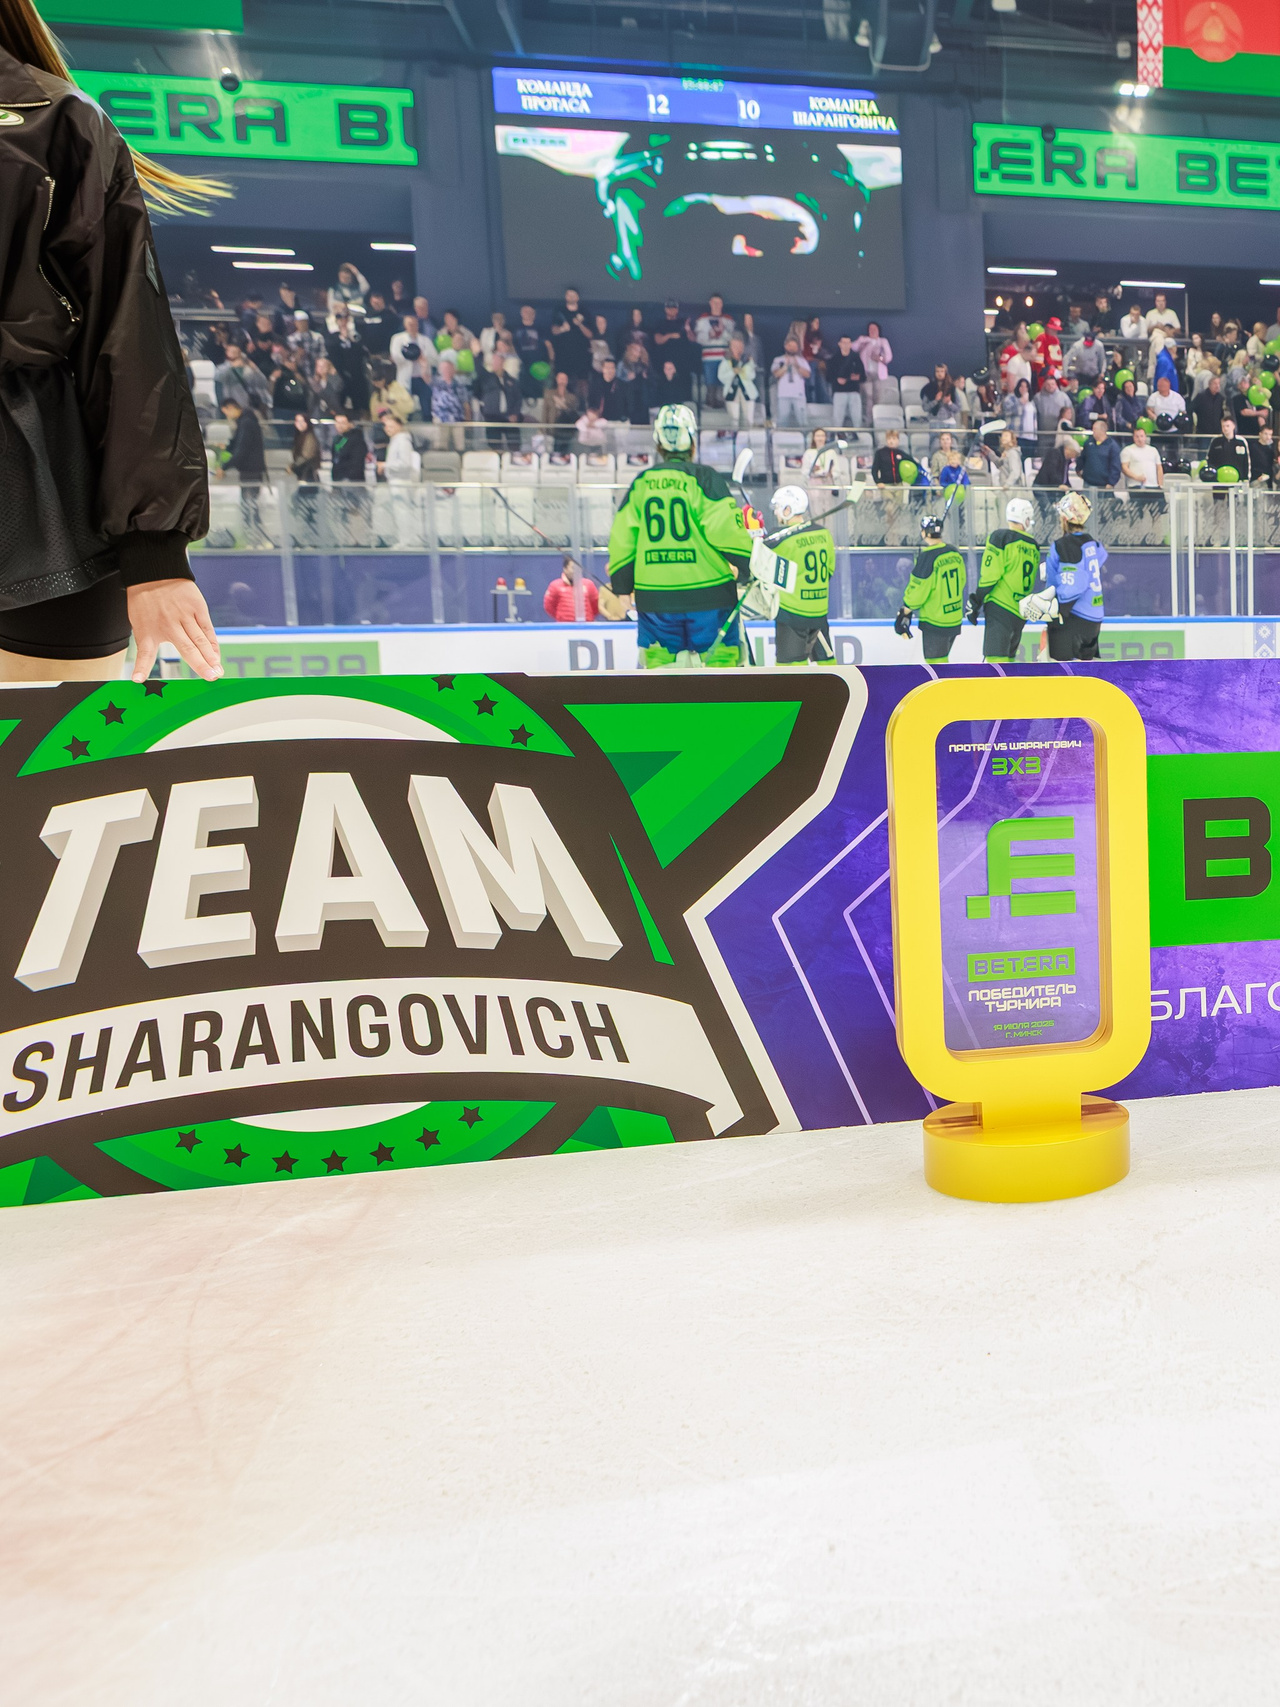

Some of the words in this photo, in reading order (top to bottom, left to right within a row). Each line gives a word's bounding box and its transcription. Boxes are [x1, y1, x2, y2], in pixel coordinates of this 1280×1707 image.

[516, 79, 593, 98] КОМАНДА
[520, 95, 591, 114] ПРОТАСА
[647, 94, 670, 115] 12
[738, 99, 761, 120] 10
[809, 96, 879, 115] КОМАНДА
[99, 89, 288, 143] ERA
[337, 103, 414, 147] B
[792, 111, 898, 131] ШАРАНГОВИЧА
[644, 496, 692, 543] 60
[804, 549, 828, 584] 98
[1022, 560, 1034, 592] 8
[941, 567, 960, 599] 17
[948, 743, 991, 753] ПРОТАС
[993, 742, 1008, 751] VS
[1009, 740, 1082, 751] ШАРАНГОВИЧ
[991, 756, 1041, 776] 3X3
[14, 771, 624, 992] TEAM
[968, 983, 1077, 1002] ПОБЕДИТЕЛЬ
[985, 996, 1062, 1013] ТУРНИРА
[1003, 1022, 1030, 1031] ИЮЛЯ
[1030, 1019, 1055, 1028] 2025
[1013, 1029, 1043, 1038] МИНСК
[2, 993, 630, 1113] SHARANGOVICH
